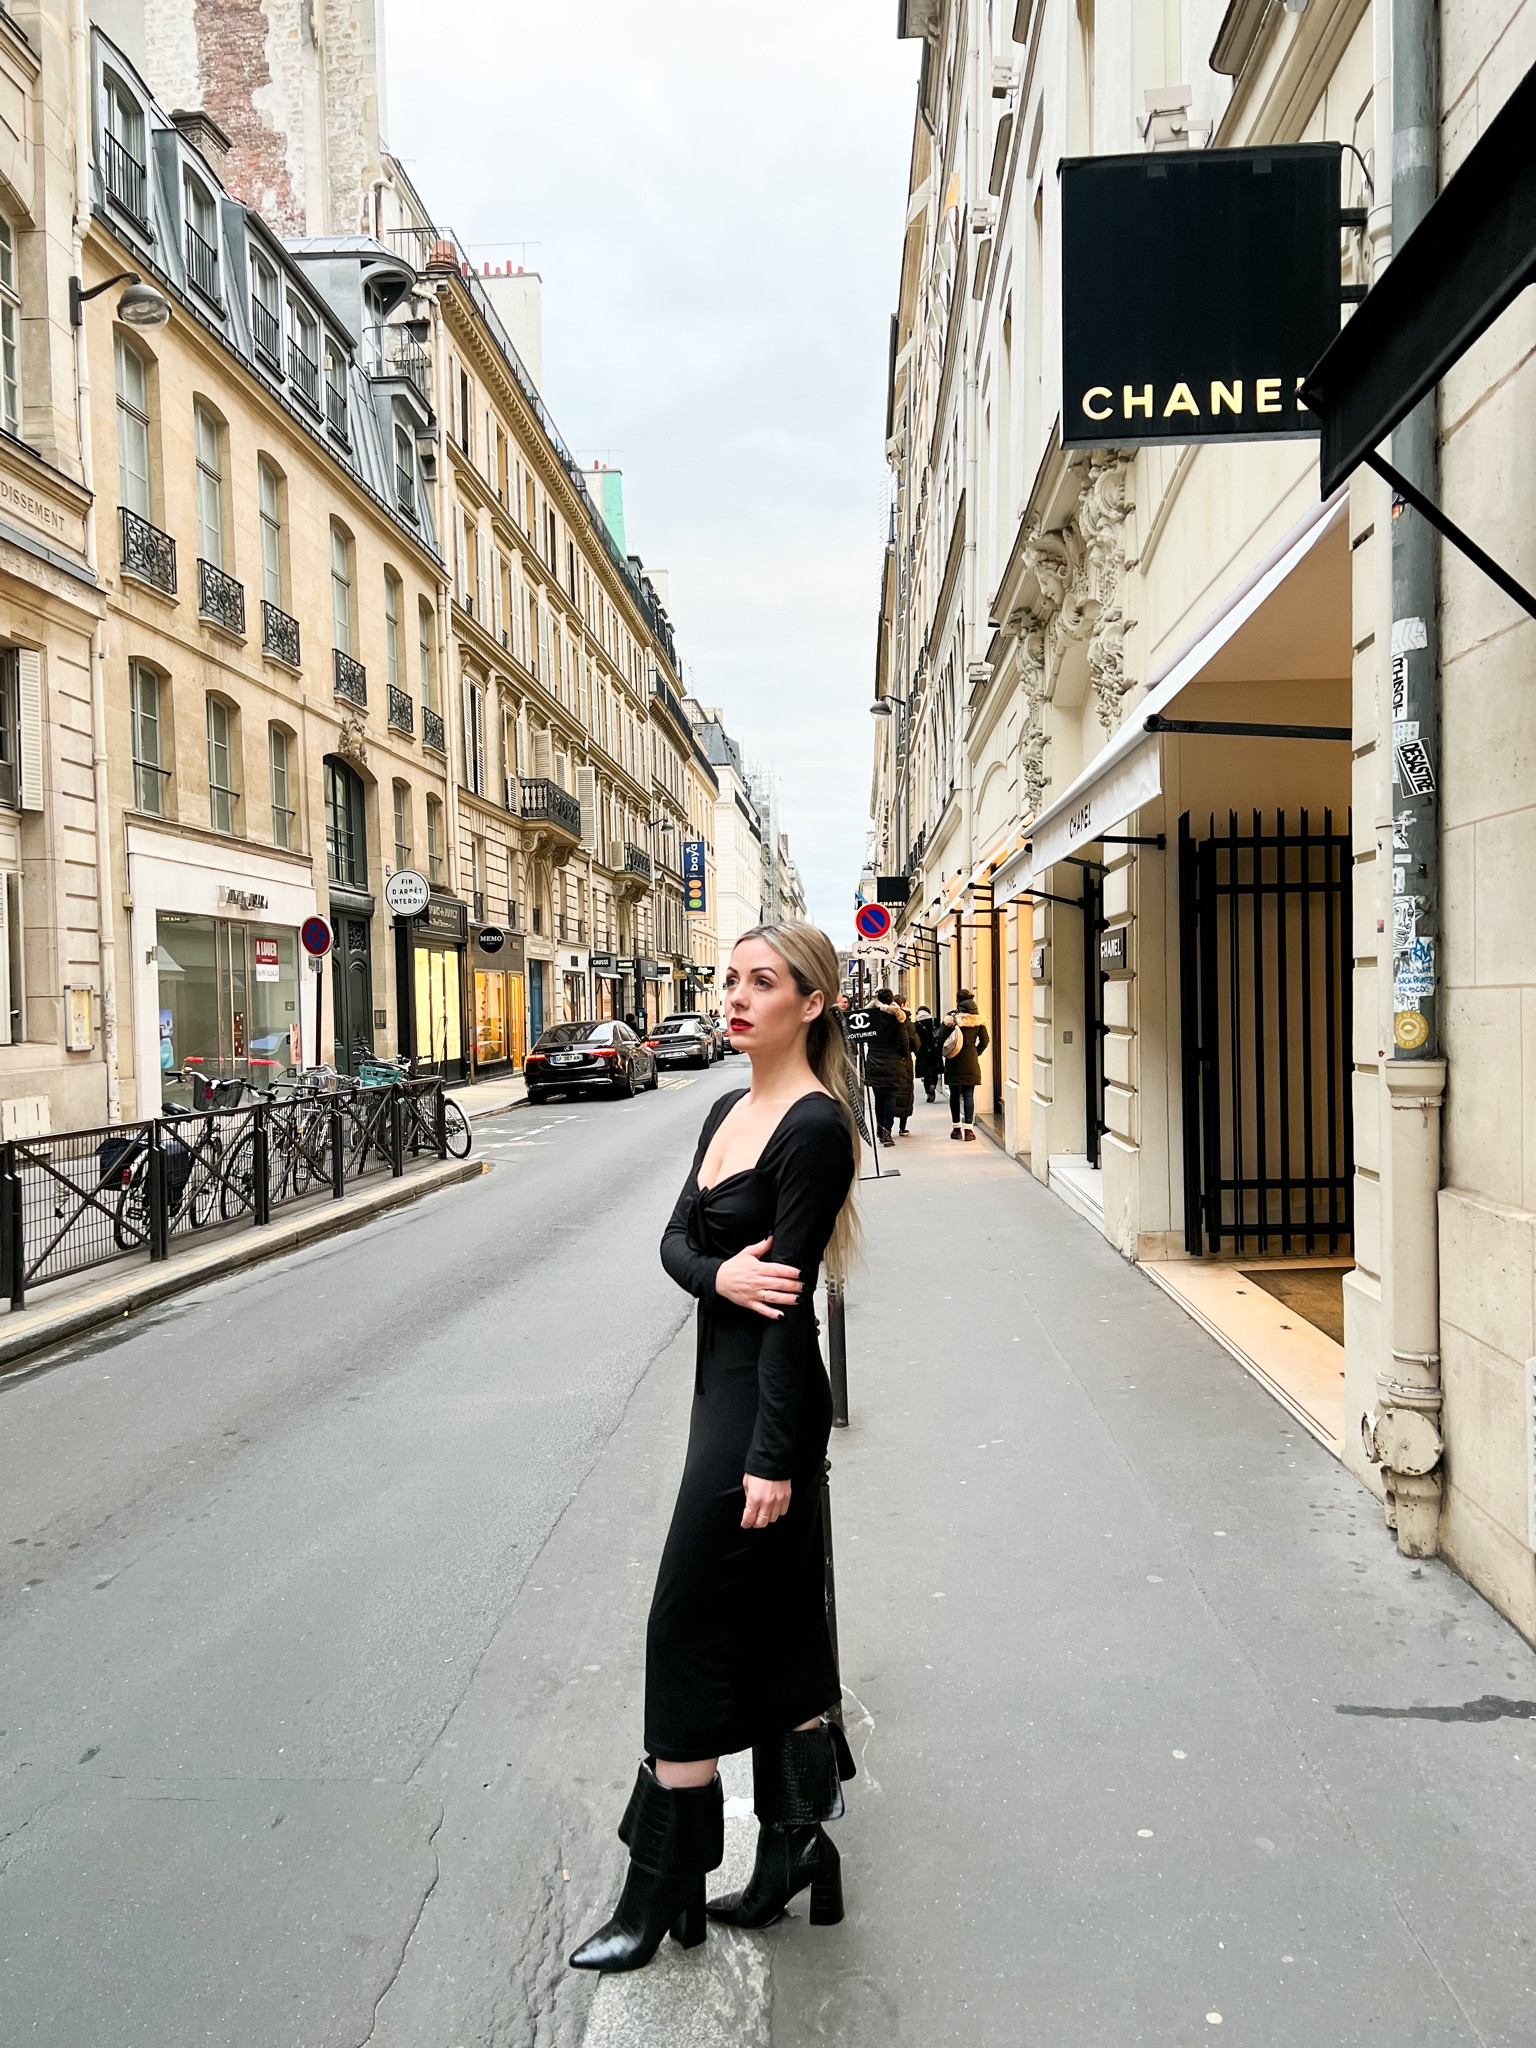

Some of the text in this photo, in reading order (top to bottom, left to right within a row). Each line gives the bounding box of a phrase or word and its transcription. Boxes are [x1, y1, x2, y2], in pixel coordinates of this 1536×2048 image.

[1399, 741, 1435, 793] DESASTRE
[685, 843, 700, 872] baya
[1101, 938, 1122, 958] CHANEL
[847, 1030, 877, 1040] VOITURIER
